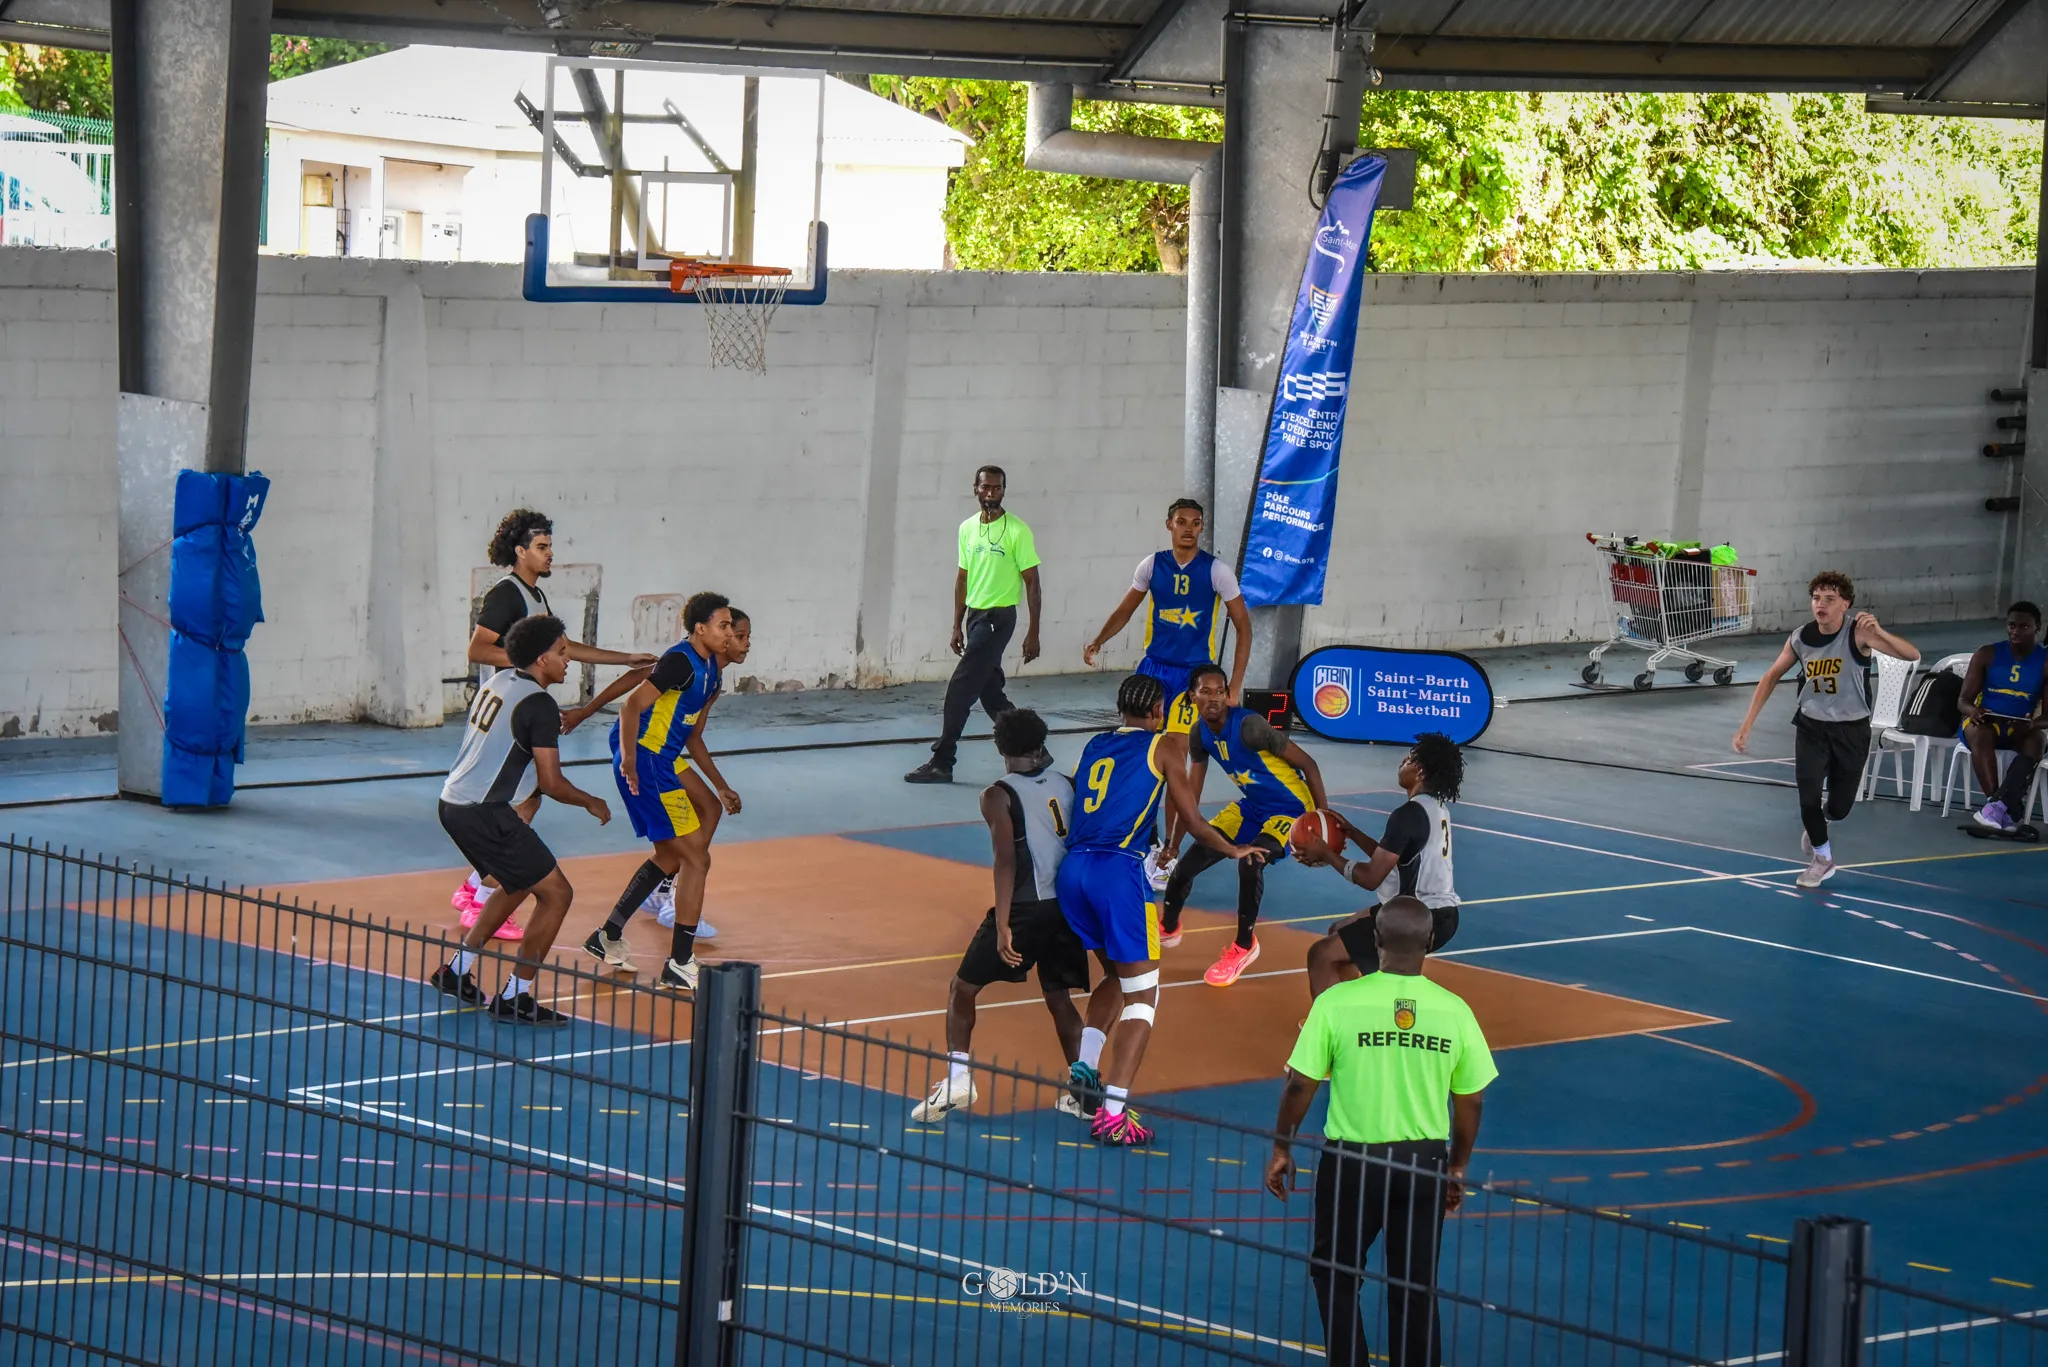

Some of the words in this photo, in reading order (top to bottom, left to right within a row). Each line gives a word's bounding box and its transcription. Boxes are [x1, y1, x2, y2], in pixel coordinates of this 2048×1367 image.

[1280, 421, 1286, 430] &
[1282, 432, 1296, 445] PAR
[1296, 436, 1306, 448] LE
[1266, 491, 1289, 504] PÔLE
[1264, 501, 1311, 520] PARCOURS
[1262, 510, 1324, 532] PERFORMANCE
[1173, 573, 1190, 596] 13
[1806, 657, 1843, 678] SUNS
[2009, 664, 2021, 683] 5
[1374, 671, 1470, 689] Saint-Barth
[1812, 676, 1837, 695] 13
[1367, 685, 1472, 704] Saint-Martin
[470, 688, 504, 734] 10
[1178, 703, 1194, 725] 13
[1267, 693, 1288, 728] 2
[1377, 701, 1461, 718] Basketball
[1083, 757, 1115, 814] 9
[1048, 797, 1068, 838] 1
[1273, 819, 1292, 836] 10
[1441, 818, 1449, 859] 3
[1358, 1031, 1452, 1054] REFEREE
